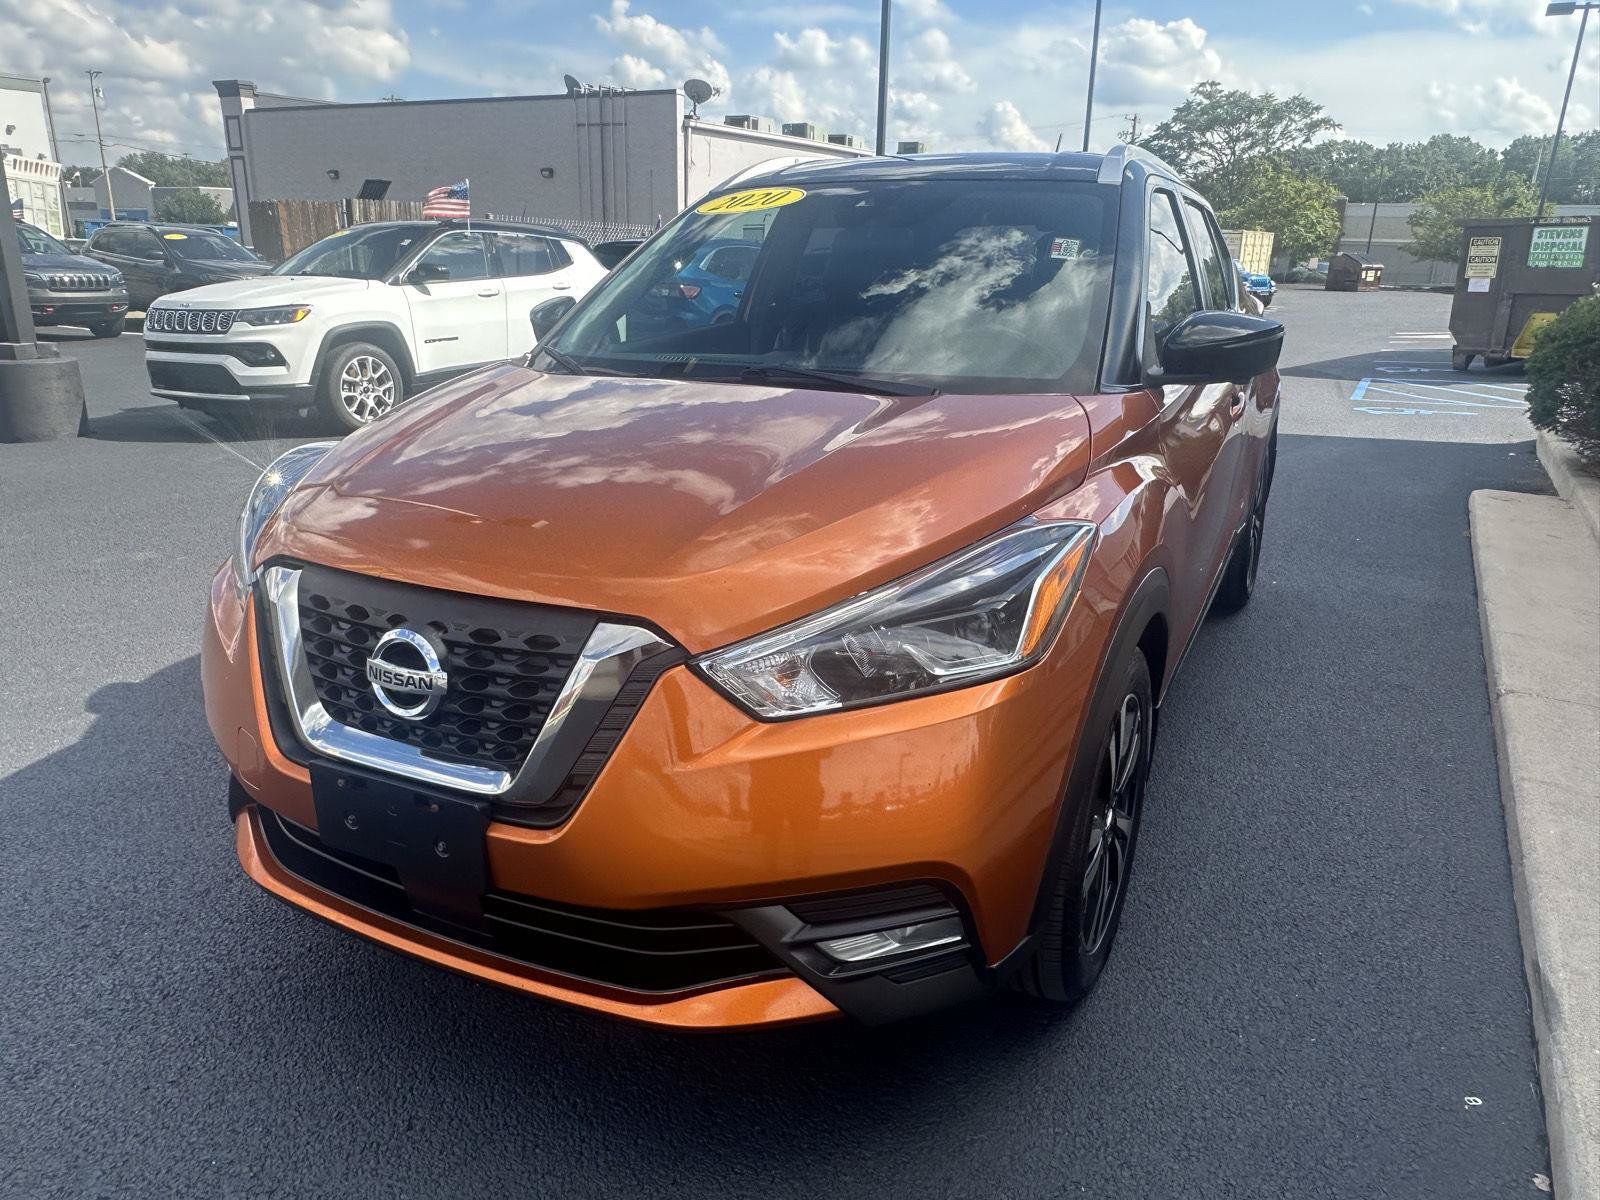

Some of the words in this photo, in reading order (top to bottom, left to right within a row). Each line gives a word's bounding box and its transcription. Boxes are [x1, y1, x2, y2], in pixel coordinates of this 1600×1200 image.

[707, 190, 792, 212] 2020
[1537, 229, 1583, 240] STEVENS
[1473, 238, 1499, 246] CAUTION
[1532, 241, 1584, 251] DISPOSAL
[368, 664, 433, 691] NISSAN
